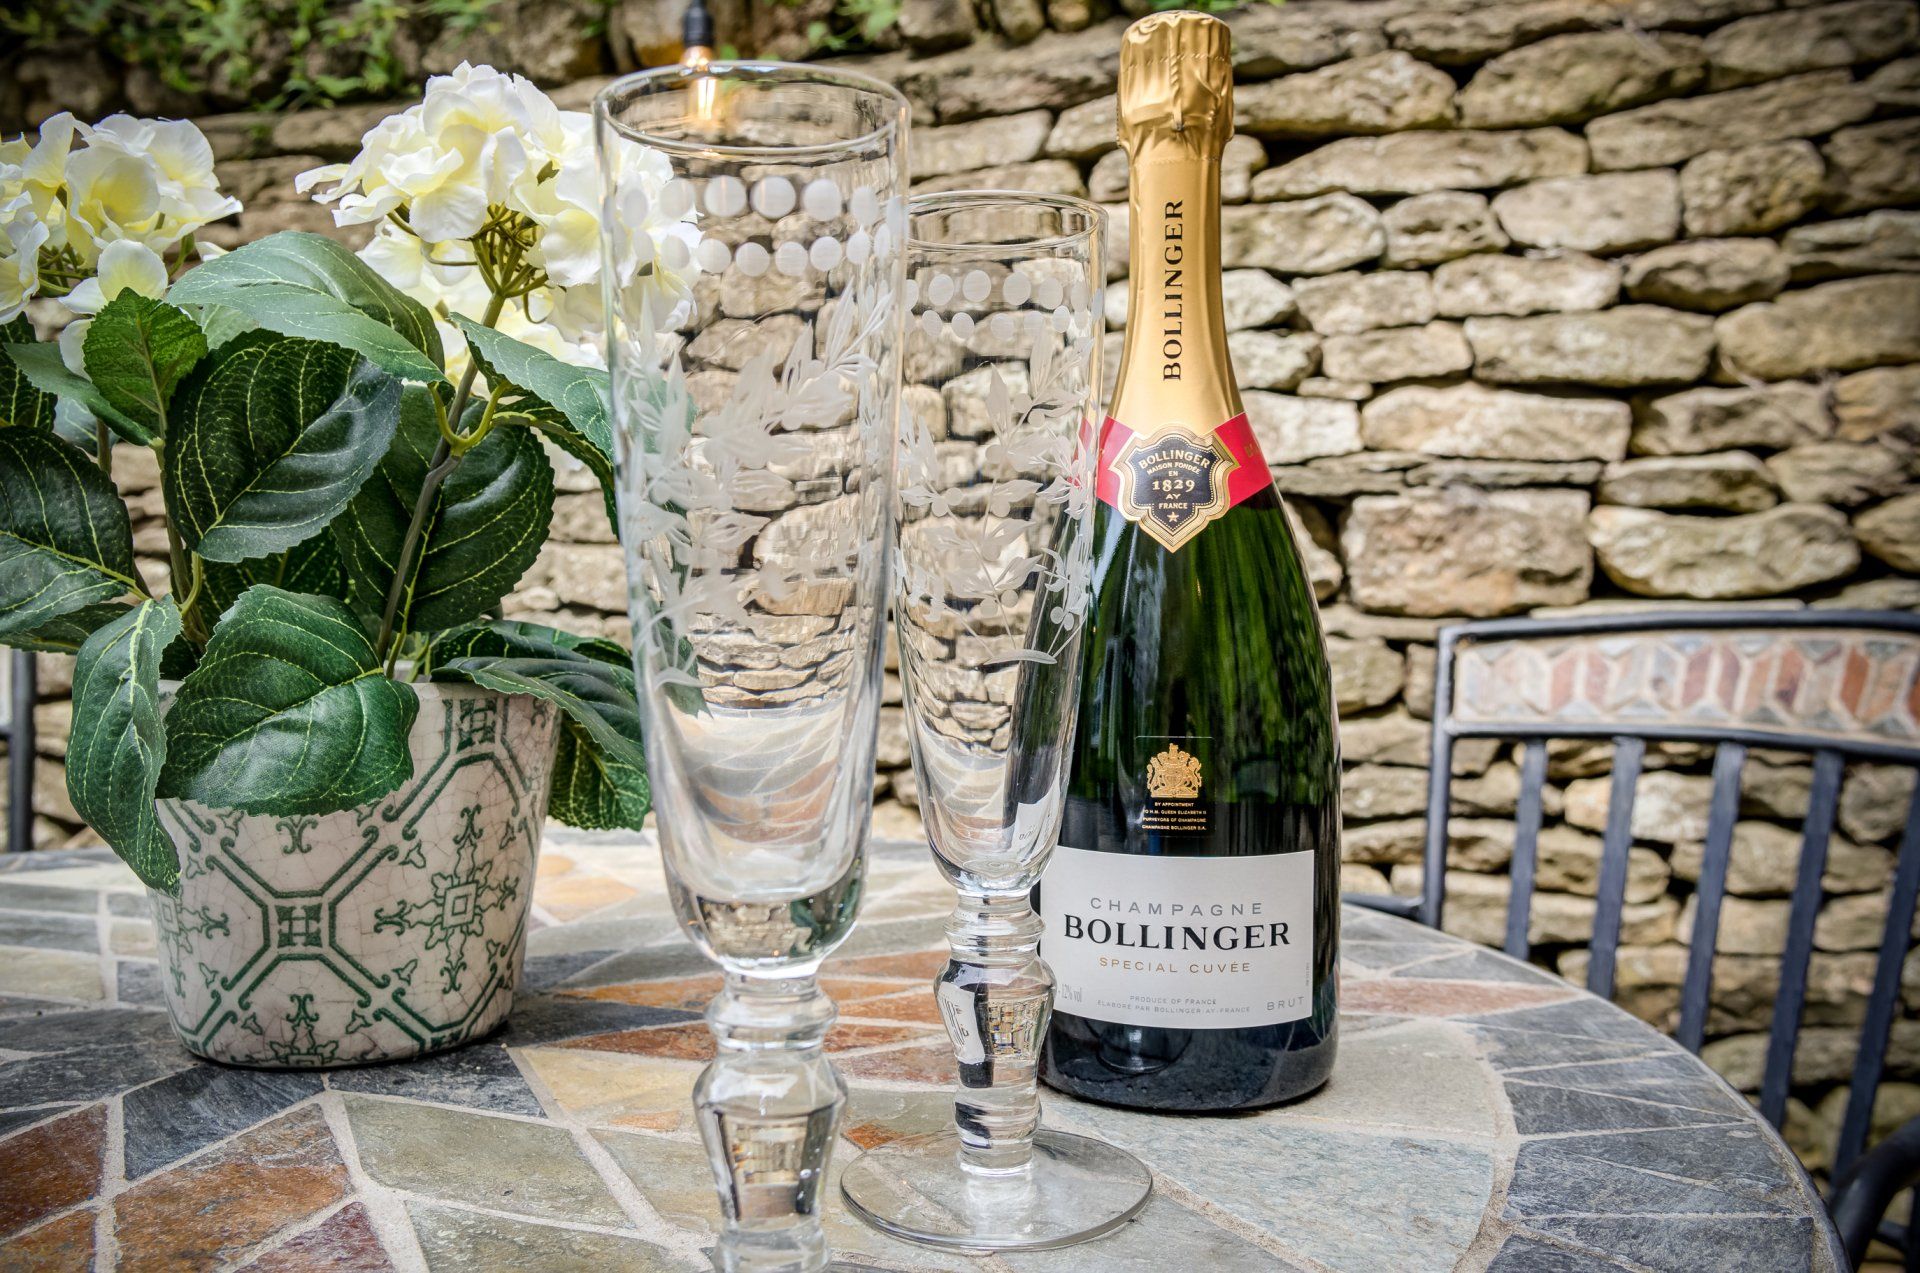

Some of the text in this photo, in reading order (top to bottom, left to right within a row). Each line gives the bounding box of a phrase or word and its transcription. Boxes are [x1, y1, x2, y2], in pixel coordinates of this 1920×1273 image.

[1163, 200, 1183, 381] BOLLINGER
[1138, 450, 1211, 469] BOLLINGER
[1147, 462, 1173, 475] MAISON
[1152, 479, 1195, 492] 1829
[1090, 897, 1262, 916] CHAMPAGNE
[1064, 914, 1290, 950] BOLLINGER
[1099, 957, 1250, 974] SPECIAL CUVÉE
[1129, 995, 1168, 1005] PRODUCE
[1267, 996, 1304, 1011] BRUT
[1154, 1005, 1201, 1014] BOLLINGER
